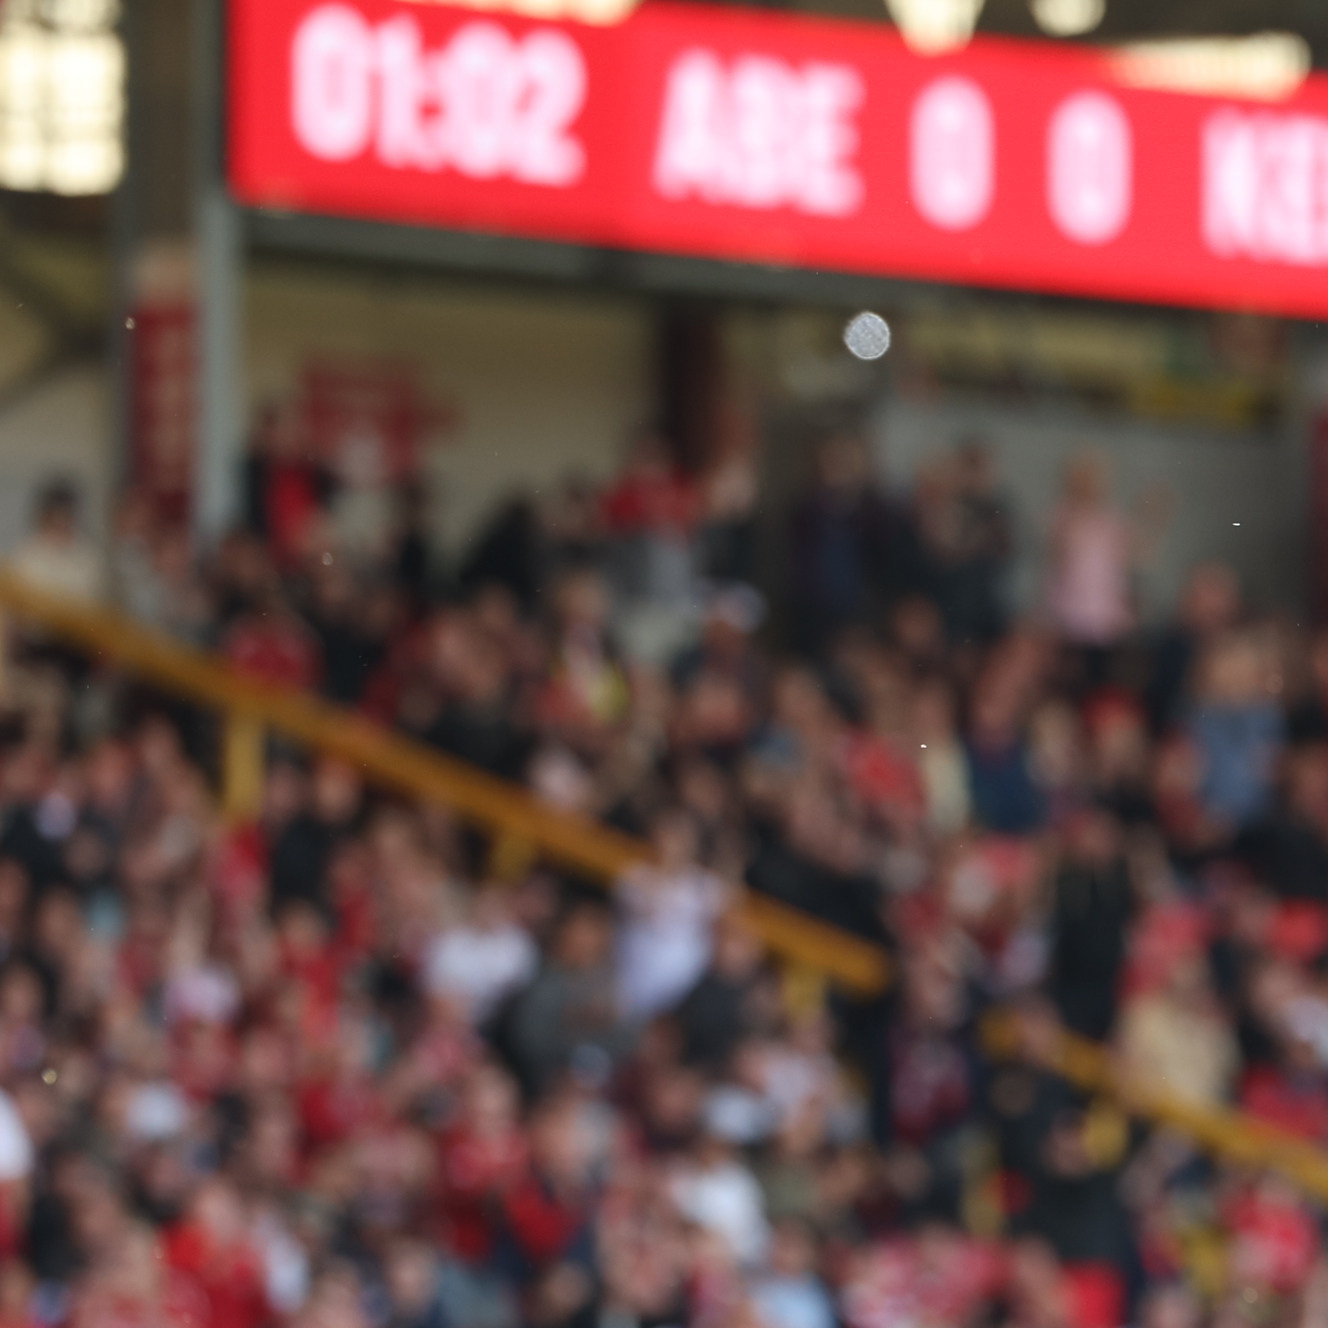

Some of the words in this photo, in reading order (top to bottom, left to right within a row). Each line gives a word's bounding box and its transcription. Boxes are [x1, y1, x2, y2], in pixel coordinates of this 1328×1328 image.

[291, 5, 585, 185] 01:02
[652, 48, 865, 216] ABE
[908, 76, 995, 231] 0
[1046, 91, 1132, 247] 0
